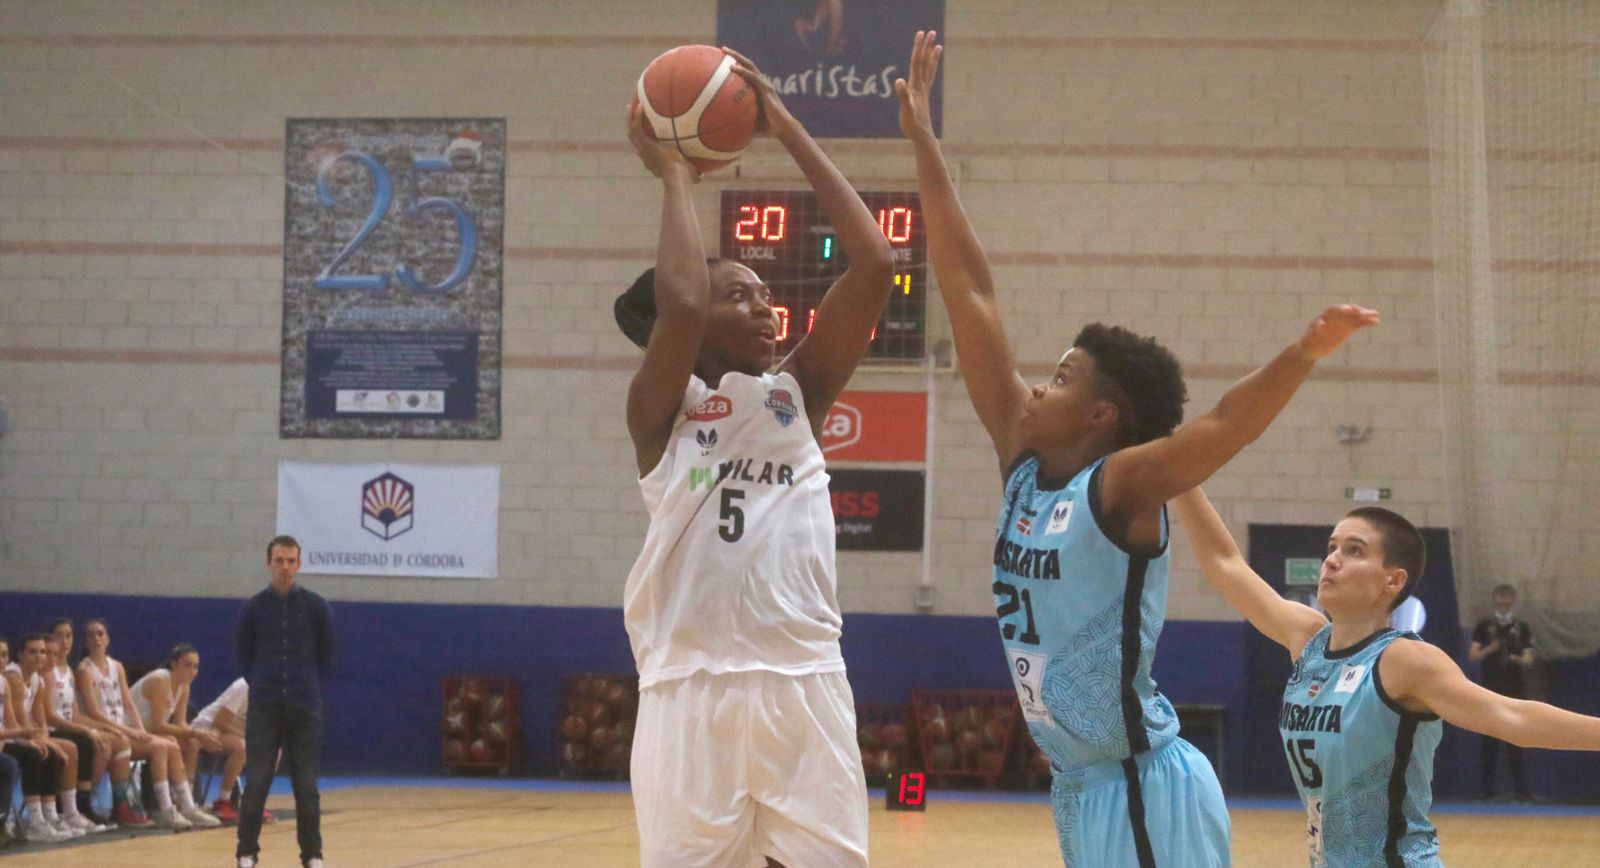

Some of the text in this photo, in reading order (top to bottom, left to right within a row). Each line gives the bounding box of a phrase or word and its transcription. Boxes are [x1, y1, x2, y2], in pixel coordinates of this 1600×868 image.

[315, 152, 477, 293] 25
[736, 206, 785, 240] 20
[880, 207, 912, 242] 10
[740, 247, 775, 259] LOCAL
[824, 237, 831, 258] 1
[718, 487, 745, 543] 5
[308, 552, 388, 566] UNIVERSIDAD
[992, 580, 1040, 646] 21
[1286, 738, 1323, 789] 15
[900, 772, 925, 804] 13
